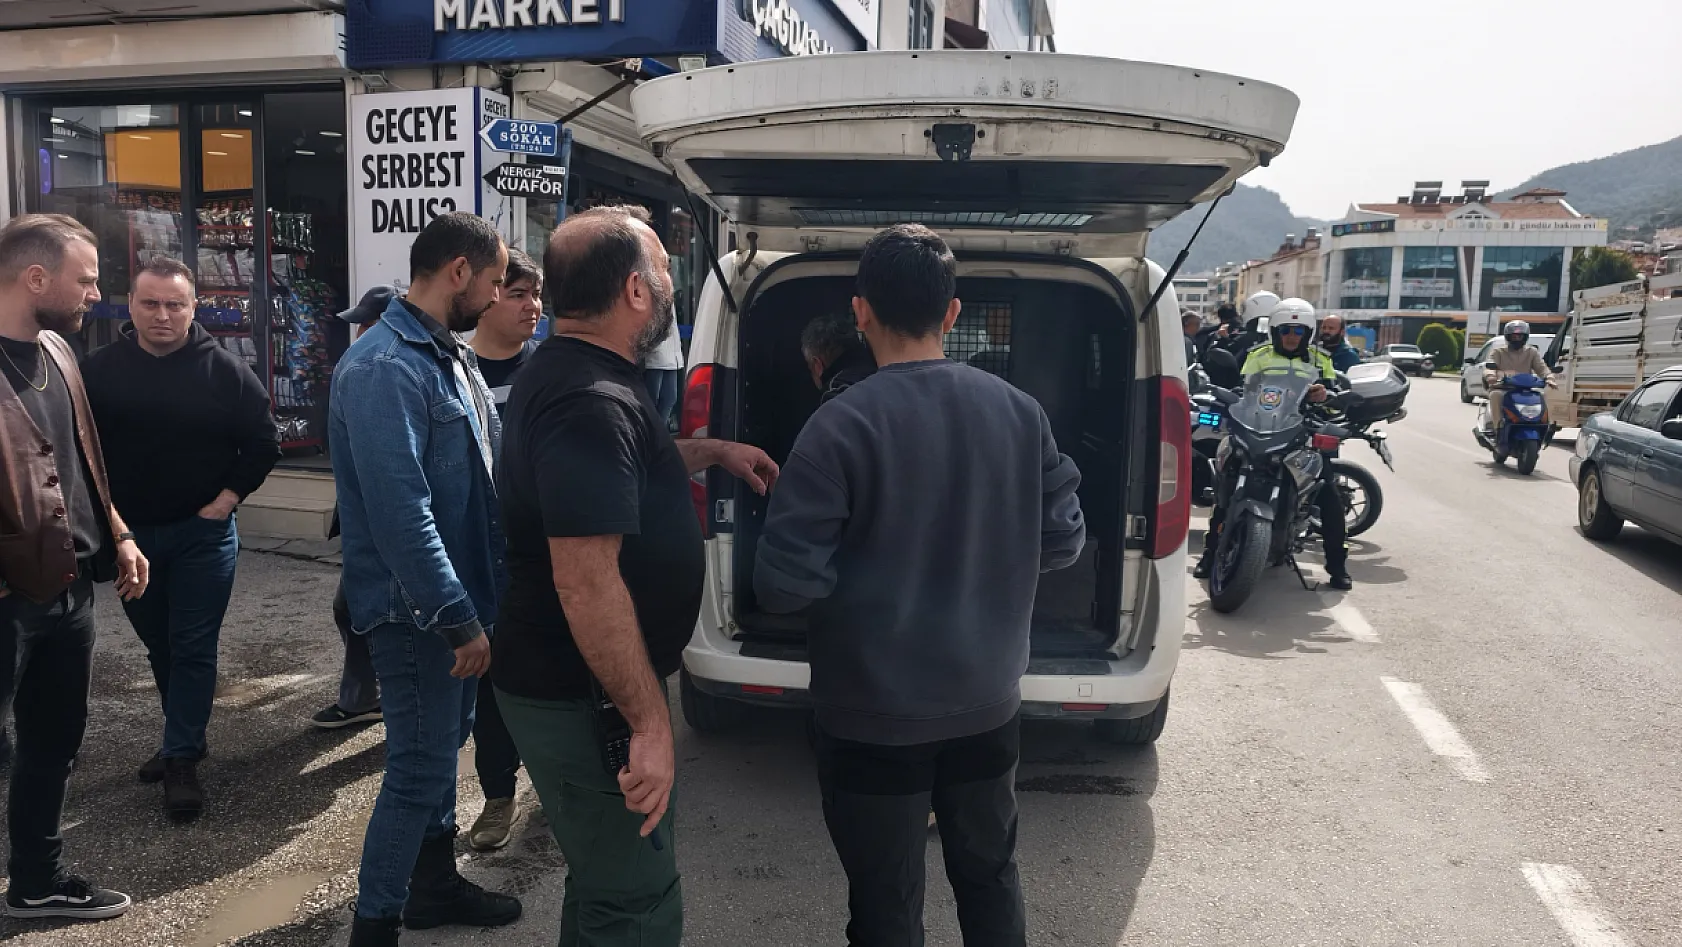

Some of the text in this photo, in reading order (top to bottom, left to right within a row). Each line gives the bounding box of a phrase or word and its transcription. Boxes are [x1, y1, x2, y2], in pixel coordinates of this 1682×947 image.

[485, 98, 507, 117] GECEYE
[365, 105, 457, 144] GECEYE
[510, 122, 542, 134] 200.
[500, 131, 552, 146] SOKAK
[361, 151, 465, 189] SERBEST
[497, 176, 562, 195] KUAFÖR
